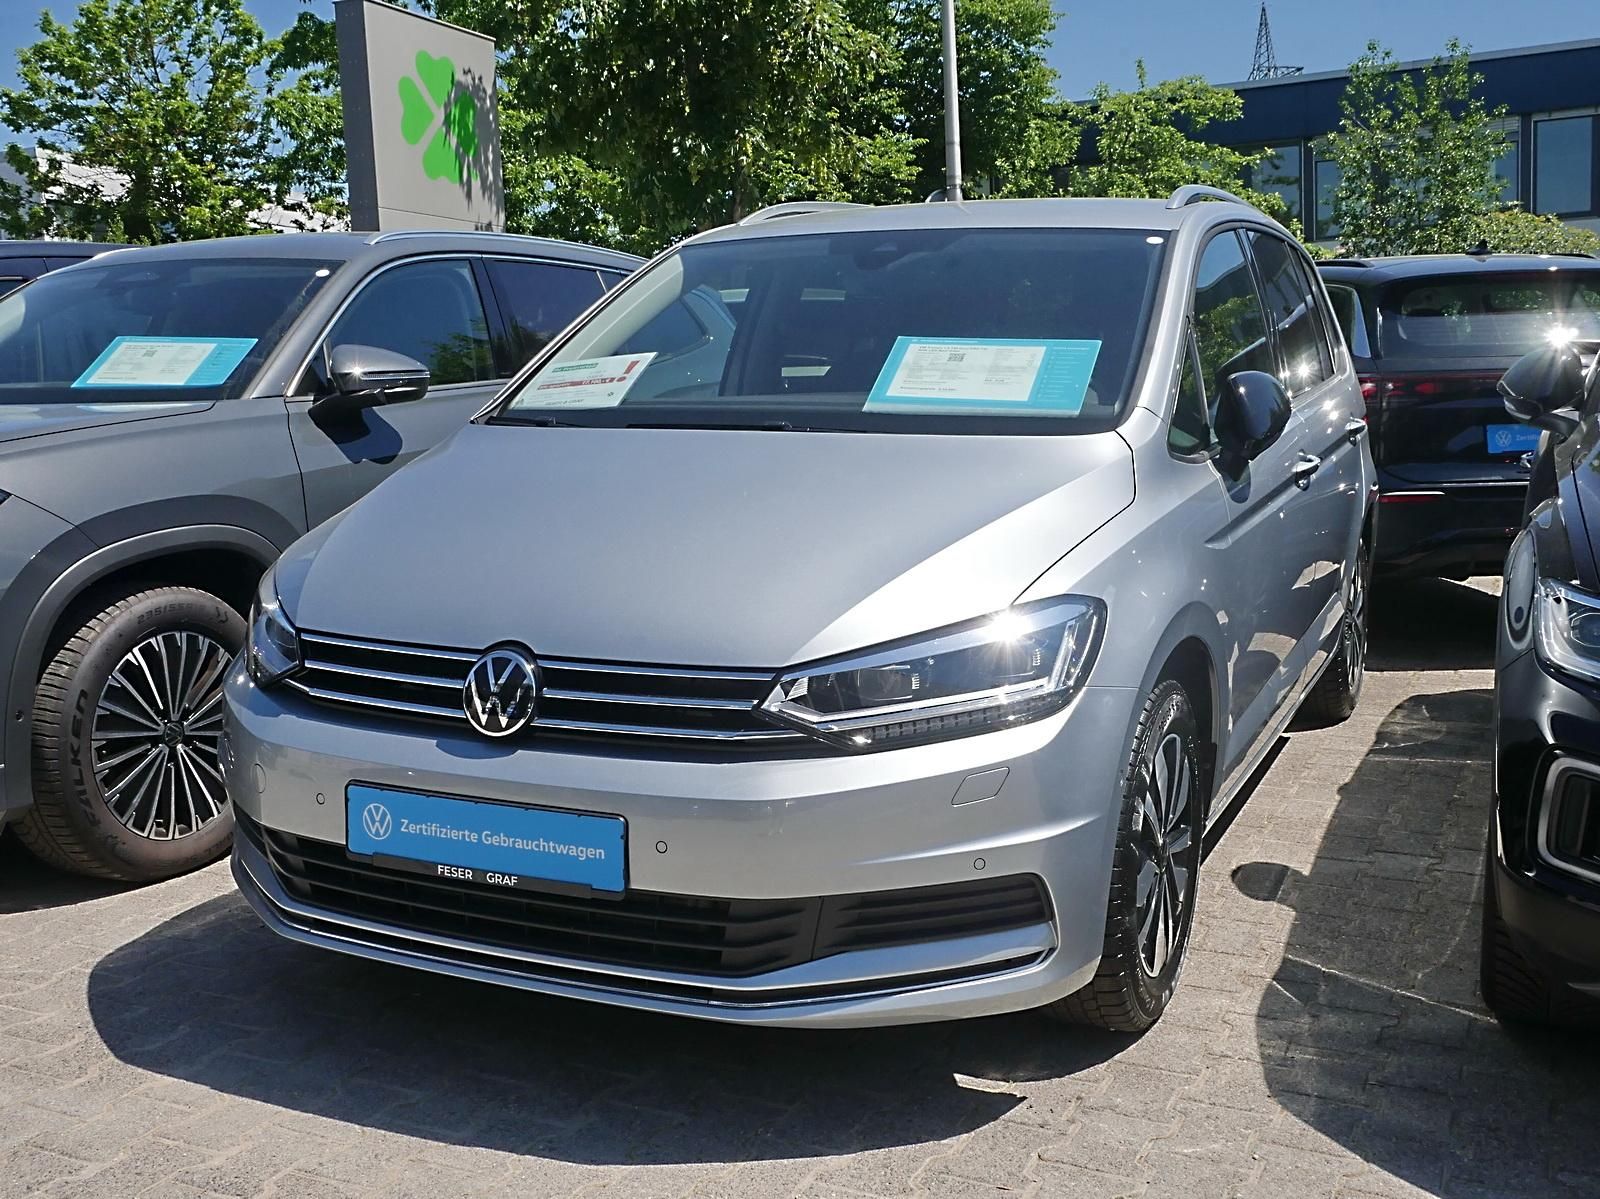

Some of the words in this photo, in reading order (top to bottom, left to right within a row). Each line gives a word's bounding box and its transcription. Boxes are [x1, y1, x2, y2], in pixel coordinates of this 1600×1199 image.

[465, 651, 534, 735] VW
[69, 688, 98, 827] FALKEN
[363, 803, 392, 840] VW
[400, 819, 478, 843] Zertifizierte
[481, 831, 606, 860] Gebrauchtwagen
[437, 864, 473, 880] FESER
[486, 872, 518, 887] GRAF
